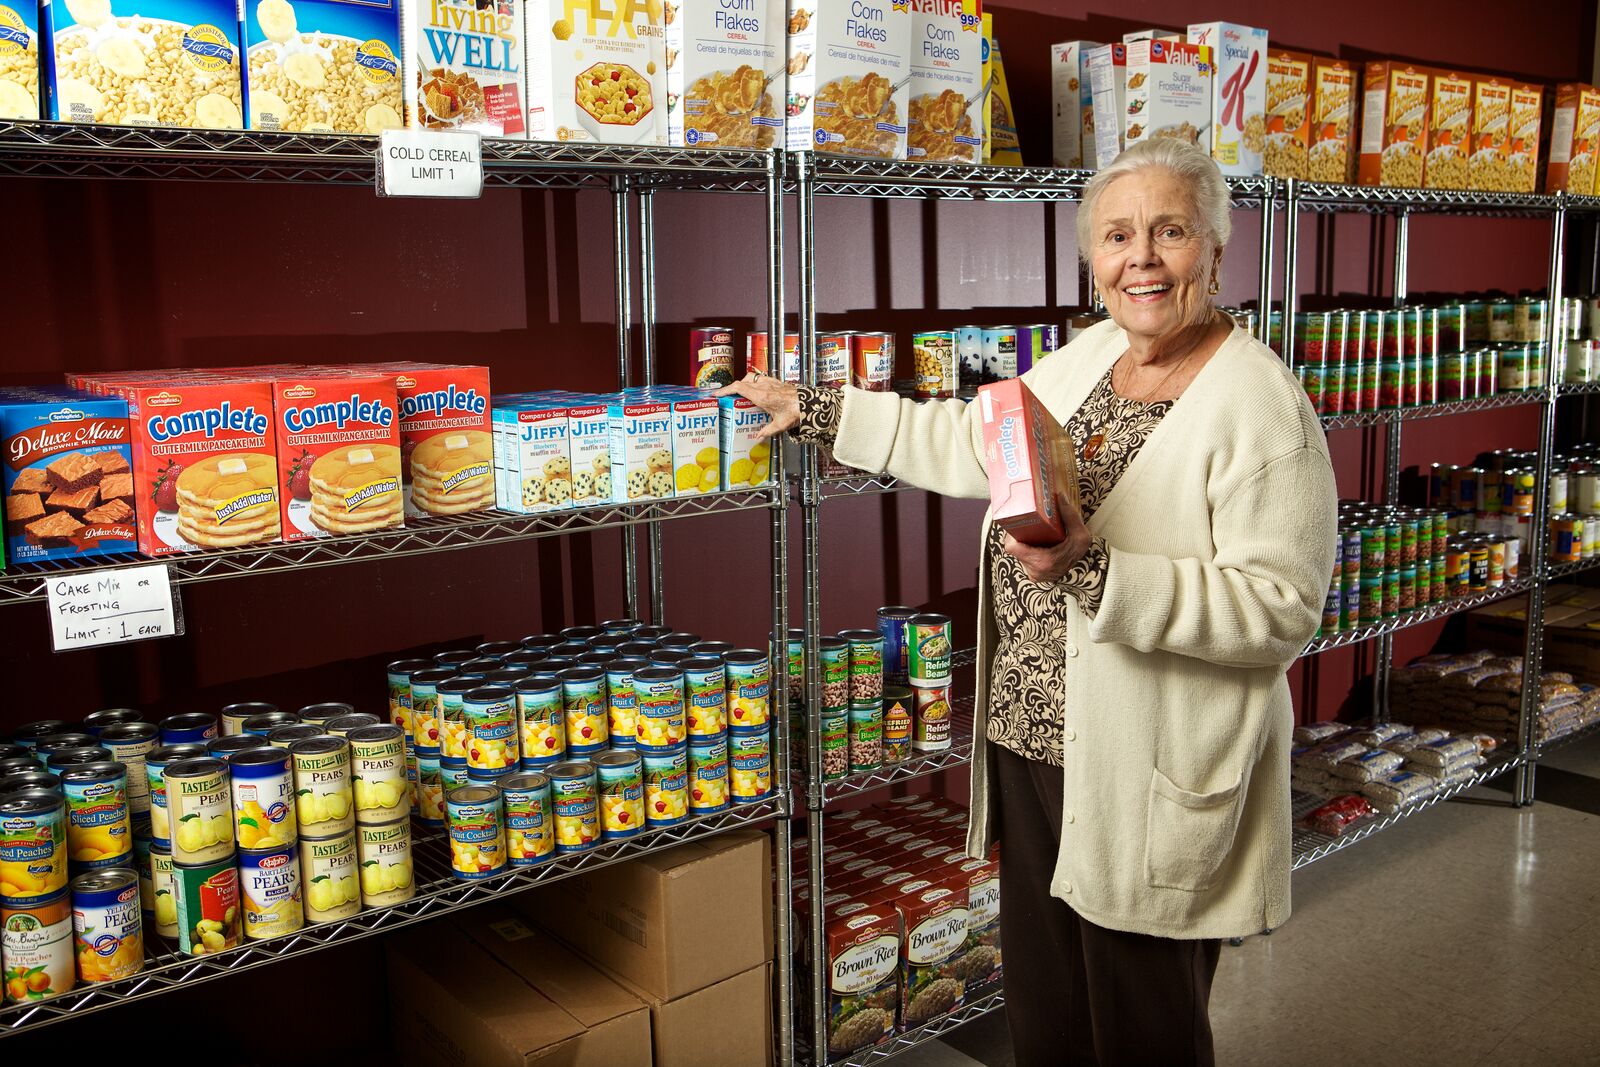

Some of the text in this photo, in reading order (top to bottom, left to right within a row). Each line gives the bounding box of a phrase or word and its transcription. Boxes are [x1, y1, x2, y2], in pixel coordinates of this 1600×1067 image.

[852, 1, 883, 21] Corn
[430, 0, 516, 49] living
[715, 11, 759, 32] Flakes
[636, 25, 664, 37] GRAINS
[846, 19, 887, 42] Flakes
[926, 24, 955, 41] Corn
[183, 40, 232, 60] Fat Free
[423, 28, 518, 72] WELL
[696, 43, 717, 53] Cereal
[857, 41, 876, 49] CEREAL
[923, 41, 959, 60] Flakes
[827, 49, 847, 58] Cereal
[1165, 42, 1200, 66] Value
[1225, 44, 1249, 60] Special
[356, 54, 396, 72] Fat Free
[1158, 80, 1182, 92] Frosted
[1221, 50, 1259, 132] K
[390, 146, 475, 163] COLD CEREAL
[411, 167, 455, 180] LIMIT 1
[571, 407, 596, 416] Compare
[625, 407, 650, 415] Compare
[656, 405, 670, 413] Save!
[675, 400, 718, 410] America's Favorite
[284, 394, 394, 433] Complete
[520, 411, 546, 421] Compare
[552, 410, 567, 418] Save!
[148, 401, 269, 443] Complete
[438, 416, 485, 429] PANCAKE MIX
[627, 419, 670, 435] JIFFY
[677, 415, 718, 430] JIFFY
[288, 428, 392, 447] BUTTERMILK PANCAKE MIX
[521, 425, 567, 441] JIFFY
[695, 428, 716, 436] muffin
[11, 421, 125, 461] Deluxe Moist
[42, 442, 79, 453] BROWNIE
[152, 437, 266, 456] BUTTERMILK PANCAKE MIX
[443, 465, 488, 490] Just Add Water
[345, 481, 396, 508] Just Add Water
[216, 491, 273, 522] Just Add Water
[84, 526, 134, 539] Deluxe Fudge
[56, 581, 90, 596] CAKE
[58, 601, 120, 615] FROSTING
[120, 621, 132, 639] 1
[138, 625, 161, 635] EACH
[926, 658, 950, 670] Refried
[926, 669, 948, 678] Beans
[741, 688, 758, 697] Fruit
[612, 697, 627, 705] Fruit
[694, 697, 711, 706] Fruit
[641, 706, 656, 715] Fruit
[476, 728, 493, 738] Fruit
[926, 721, 950, 733] Refried
[926, 732, 948, 741] Beans
[297, 758, 321, 769] TASTE
[362, 759, 394, 770] PEARS
[312, 769, 344, 782] PEARS
[699, 769, 716, 779] Fruit
[85, 786, 114, 796] Springfield
[181, 782, 209, 793] TASTE
[663, 781, 679, 790] Fruit
[199, 790, 229, 805] PEARS
[4, 821, 34, 829] Springfield
[71, 814, 96, 824] Sliced
[512, 817, 542, 827] Cocktail
[363, 830, 387, 841] TASTE
[466, 829, 497, 840] Cocktail
[16, 845, 52, 858] Peaches
[312, 844, 338, 856] TASTE
[379, 840, 408, 854] PEARS
[263, 856, 287, 868] Ralphs
[329, 852, 357, 867] PEARS
[259, 865, 290, 877] BARTLETT
[252, 870, 296, 889] PEARS
[106, 904, 132, 915] YELLOW
[911, 918, 967, 949] Brown Rice
[20, 953, 52, 962] Peaches
[835, 957, 873, 978] Brown
[874, 946, 897, 964] Rice
